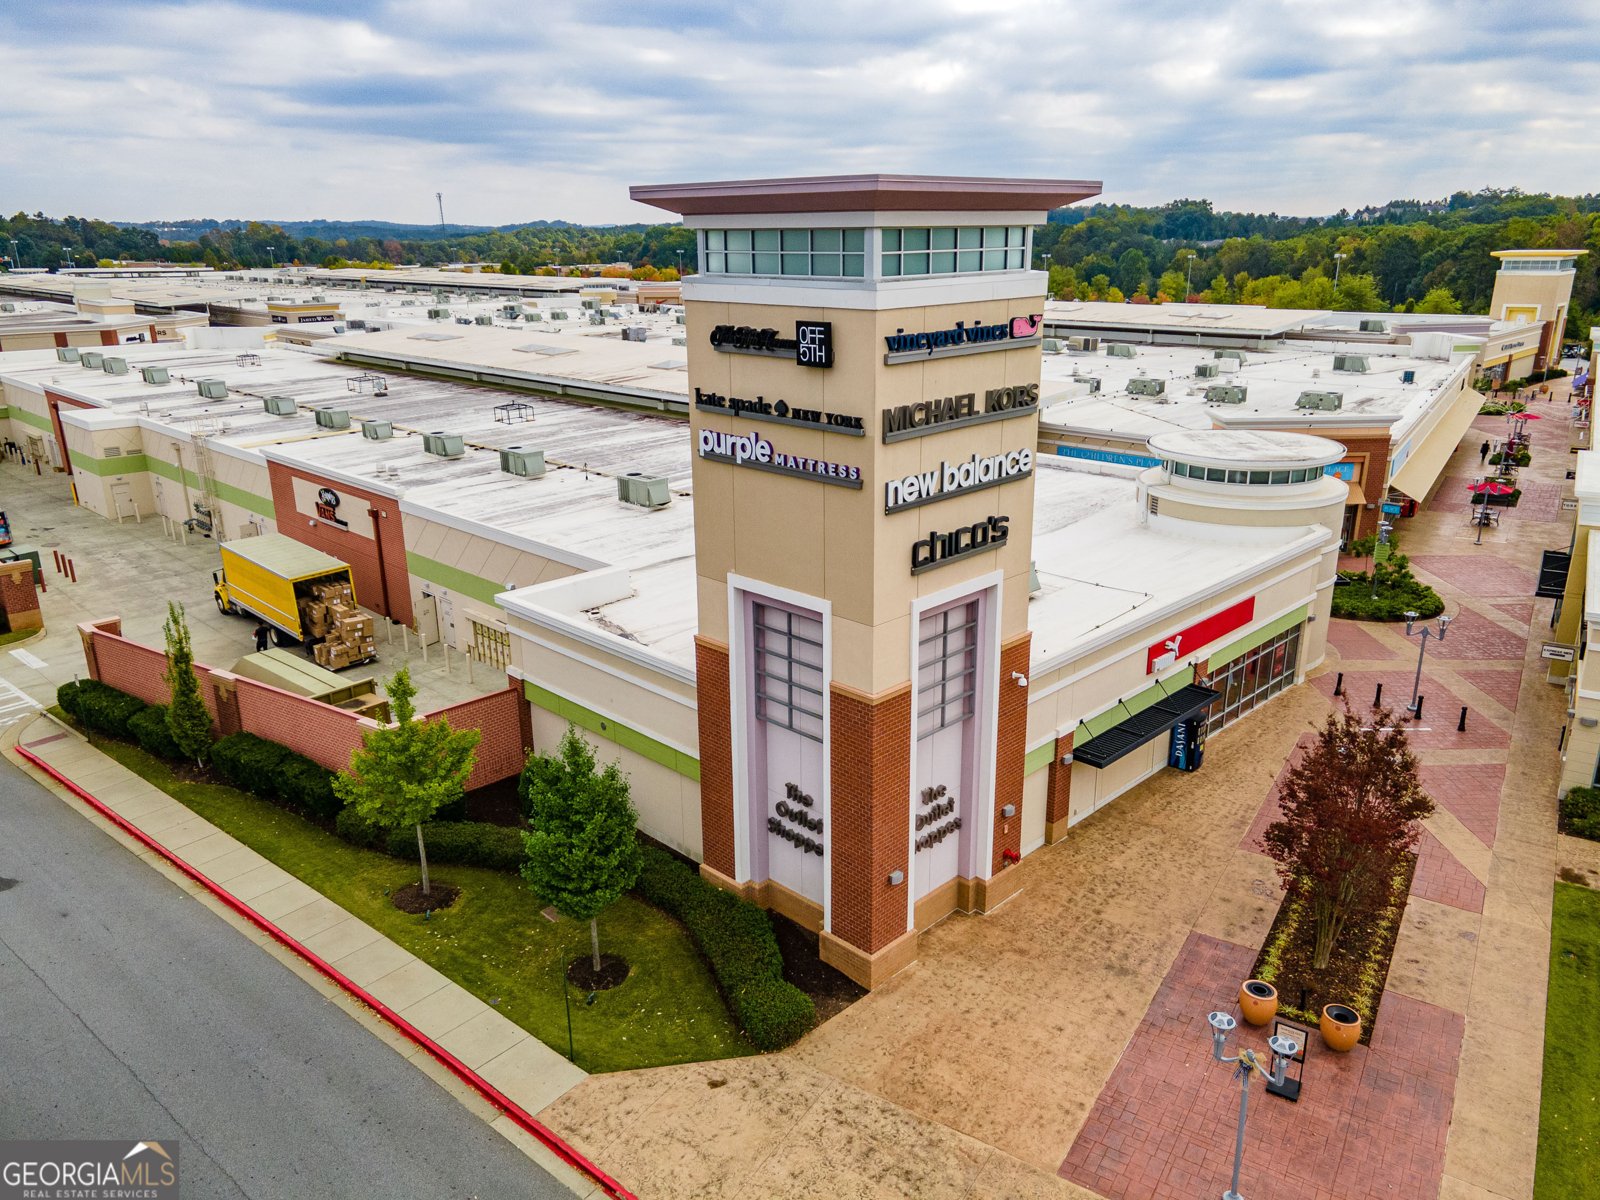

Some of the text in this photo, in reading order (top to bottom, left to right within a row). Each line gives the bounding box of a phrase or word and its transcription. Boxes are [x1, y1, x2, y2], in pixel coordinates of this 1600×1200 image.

[799, 326, 825, 345] OFF
[885, 320, 1009, 356] vineyard vines
[799, 344, 826, 363] 5TH
[695, 388, 864, 429] kate spade NEW YORK
[882, 383, 1039, 435] MICHAEL KORS
[699, 429, 861, 480] purple MATTRESS
[885, 448, 1033, 507] new balance
[912, 516, 1010, 568] chico's
[1175, 723, 1186, 757] DASANI
[785, 782, 814, 807] The
[921, 784, 947, 806] The
[775, 800, 823, 834] Outlet
